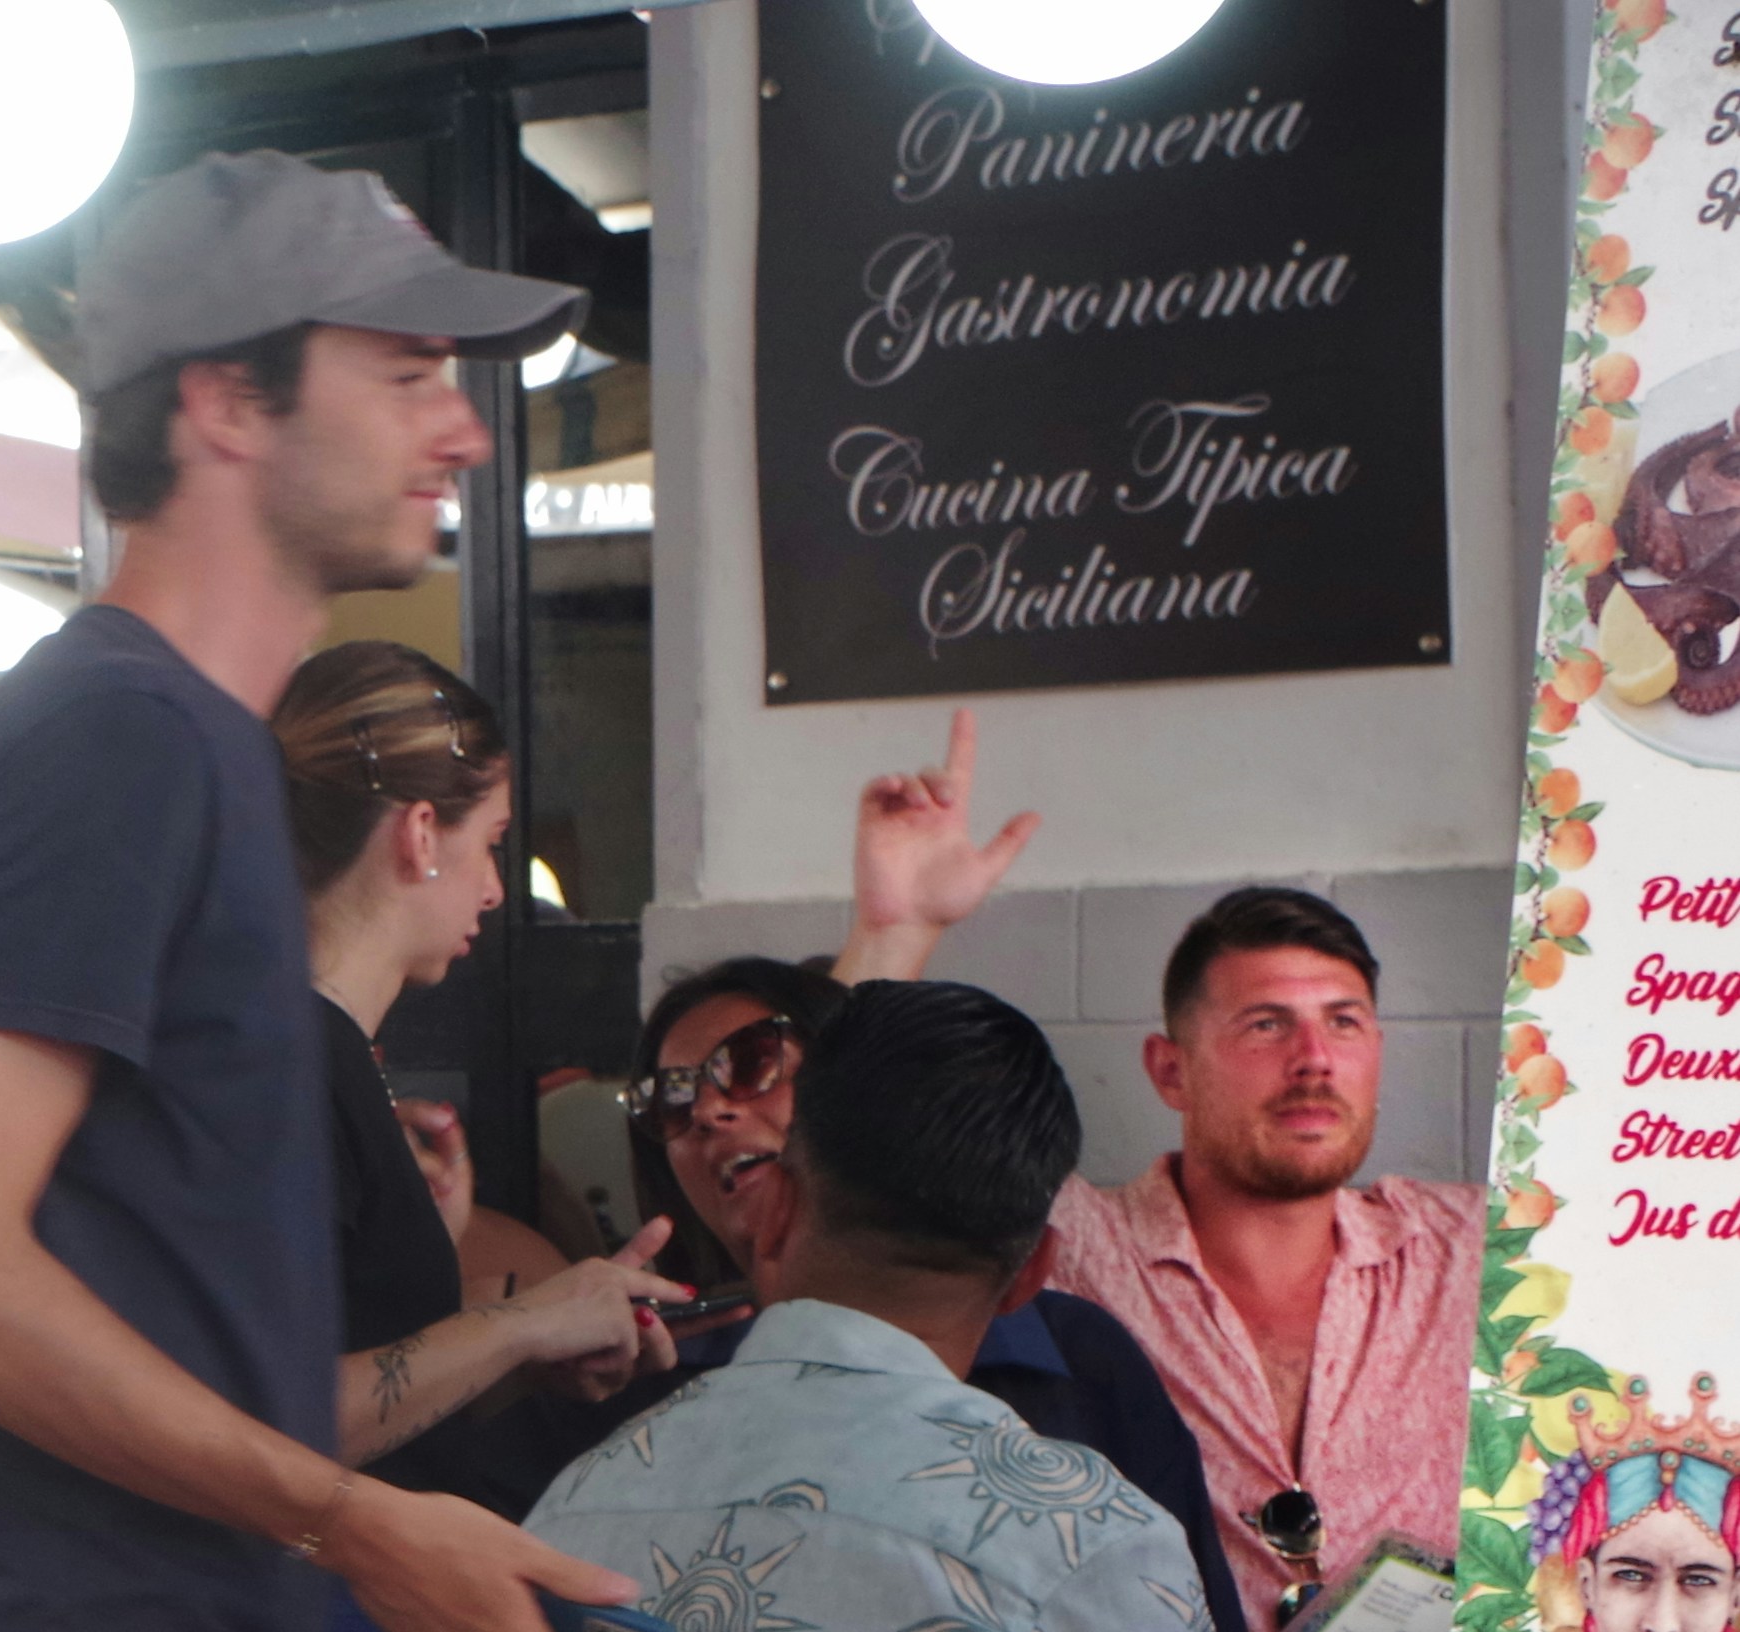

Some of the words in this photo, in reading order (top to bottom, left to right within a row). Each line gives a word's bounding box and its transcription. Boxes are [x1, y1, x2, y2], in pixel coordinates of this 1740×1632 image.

[892, 84, 1311, 203] Panineria
[843, 233, 1356, 387] Gastronomia
[828, 425, 1096, 536] Cucina
[1116, 393, 1357, 547] Tipica
[919, 528, 1259, 661] Siciliana
[1609, 1189, 1697, 1247] Jus
